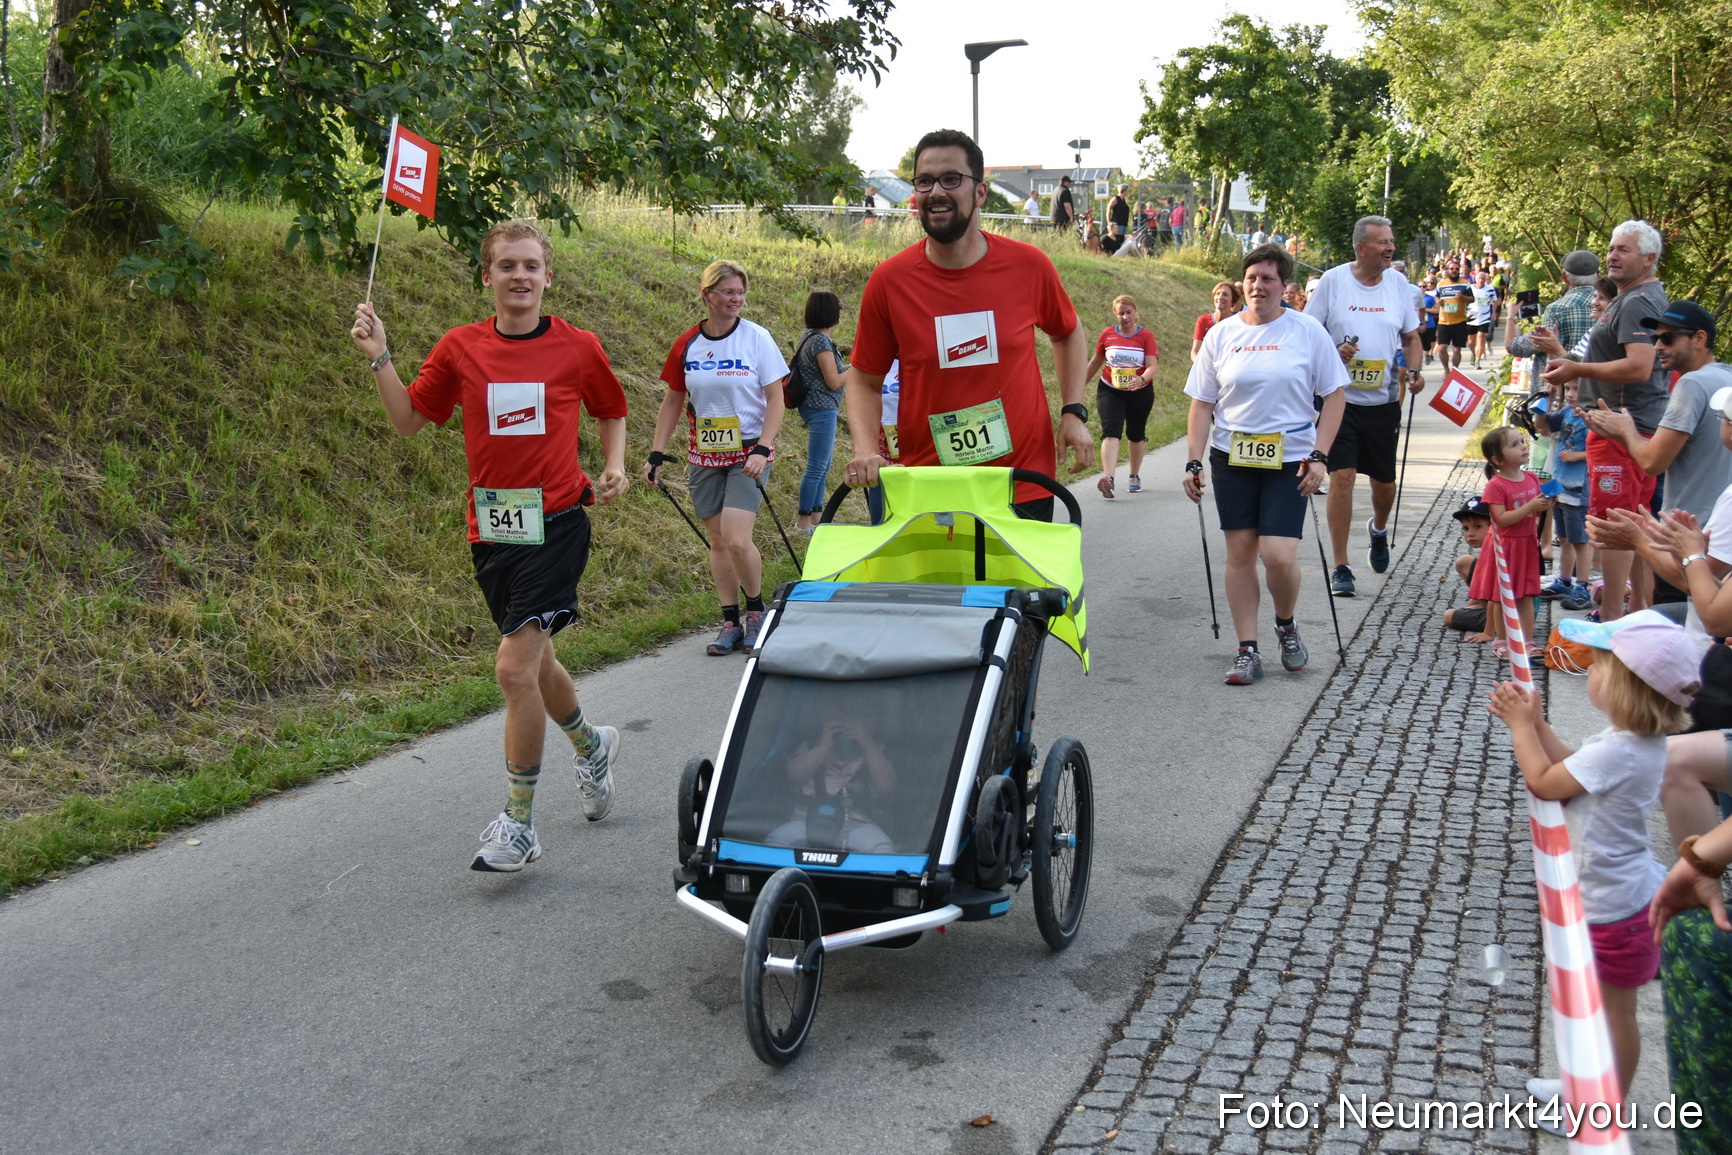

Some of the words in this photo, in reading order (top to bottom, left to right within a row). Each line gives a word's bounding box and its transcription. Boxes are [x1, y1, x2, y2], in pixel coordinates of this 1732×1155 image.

[958, 342, 977, 355] DEHN
[716, 368, 749, 377] energie
[1350, 369, 1380, 381] 1157
[507, 412, 525, 423] DEHN
[701, 429, 734, 443] 2071
[950, 424, 991, 452] 501
[976, 445, 995, 454] Martin
[1237, 441, 1276, 458] 1168
[489, 508, 524, 529] 541
[802, 852, 839, 863] THULE
